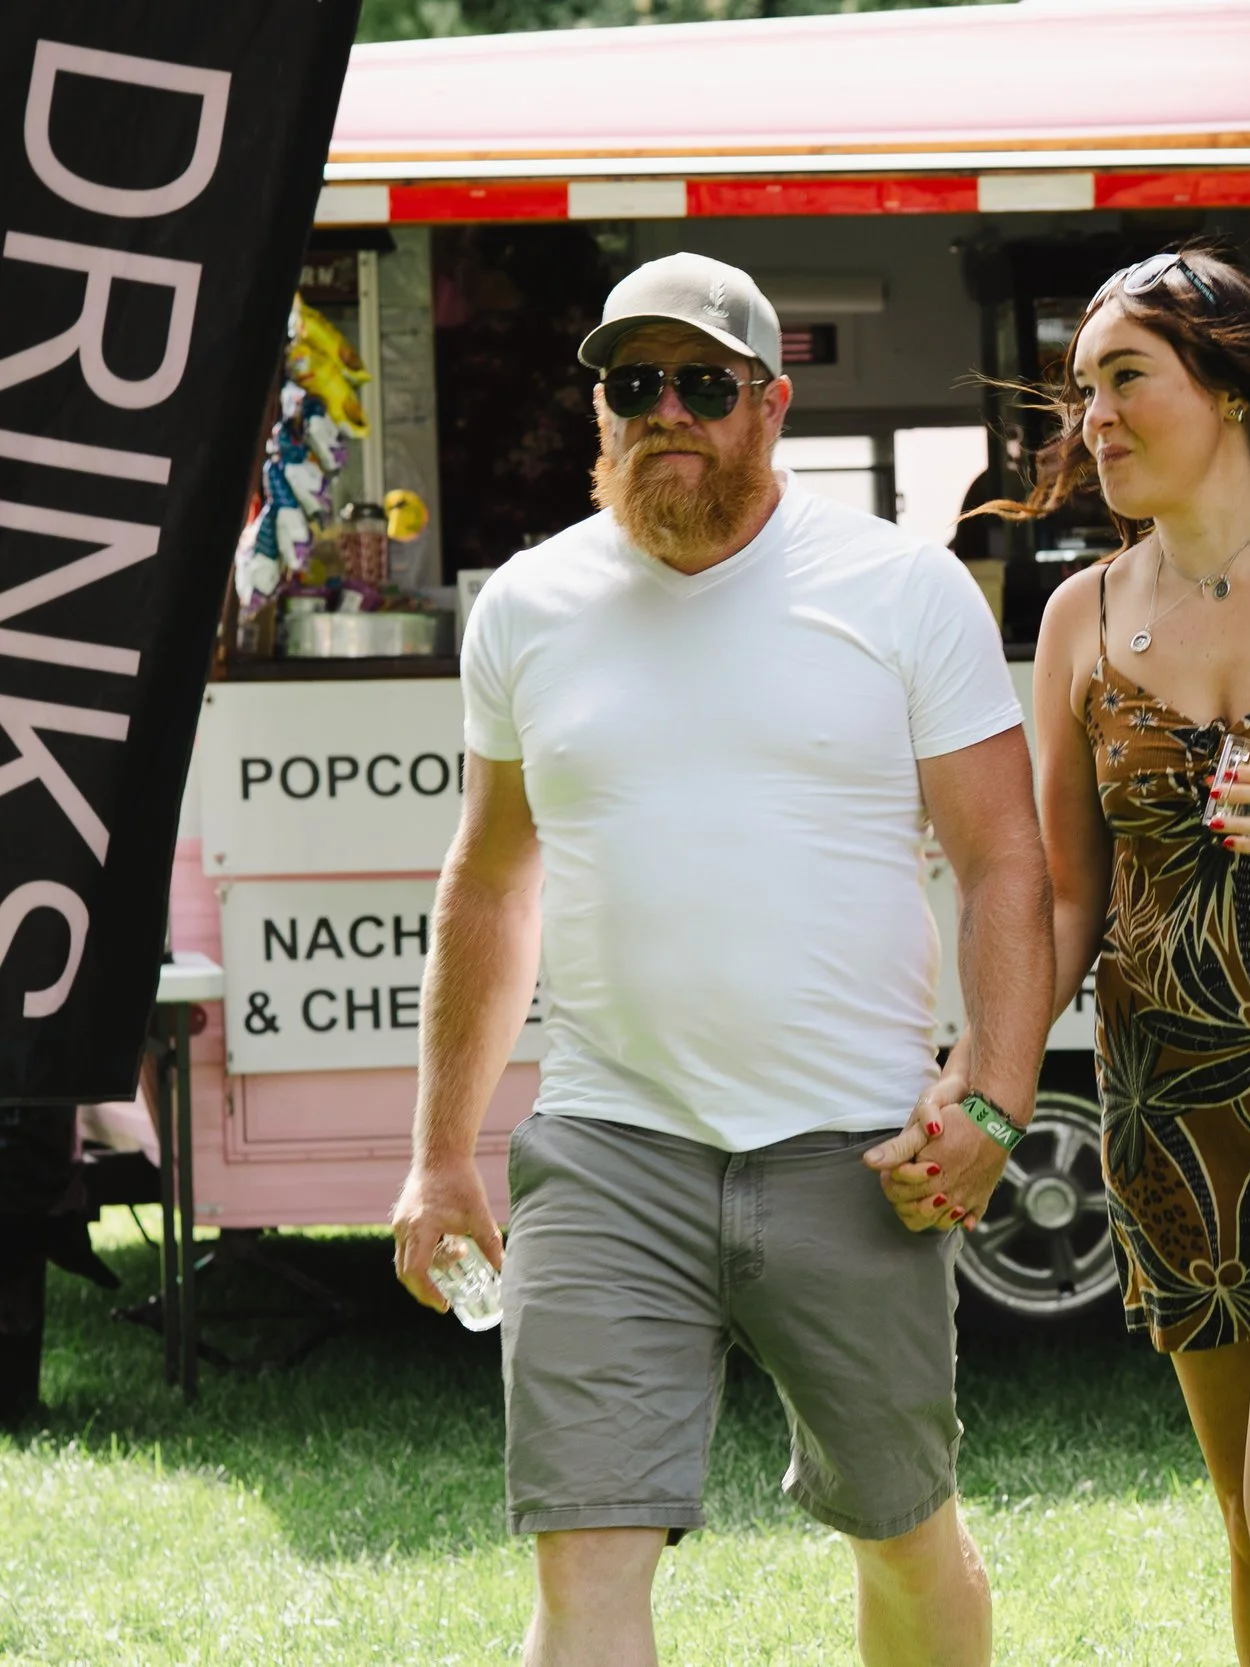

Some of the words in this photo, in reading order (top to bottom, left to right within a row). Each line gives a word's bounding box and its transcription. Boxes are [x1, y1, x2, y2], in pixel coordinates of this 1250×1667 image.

[0, 38, 232, 1020] DRINKS
[241, 752, 464, 801] POPCO
[263, 914, 429, 961] NACH
[244, 991, 280, 1035] &
[987, 1121, 1013, 1145] VIP
